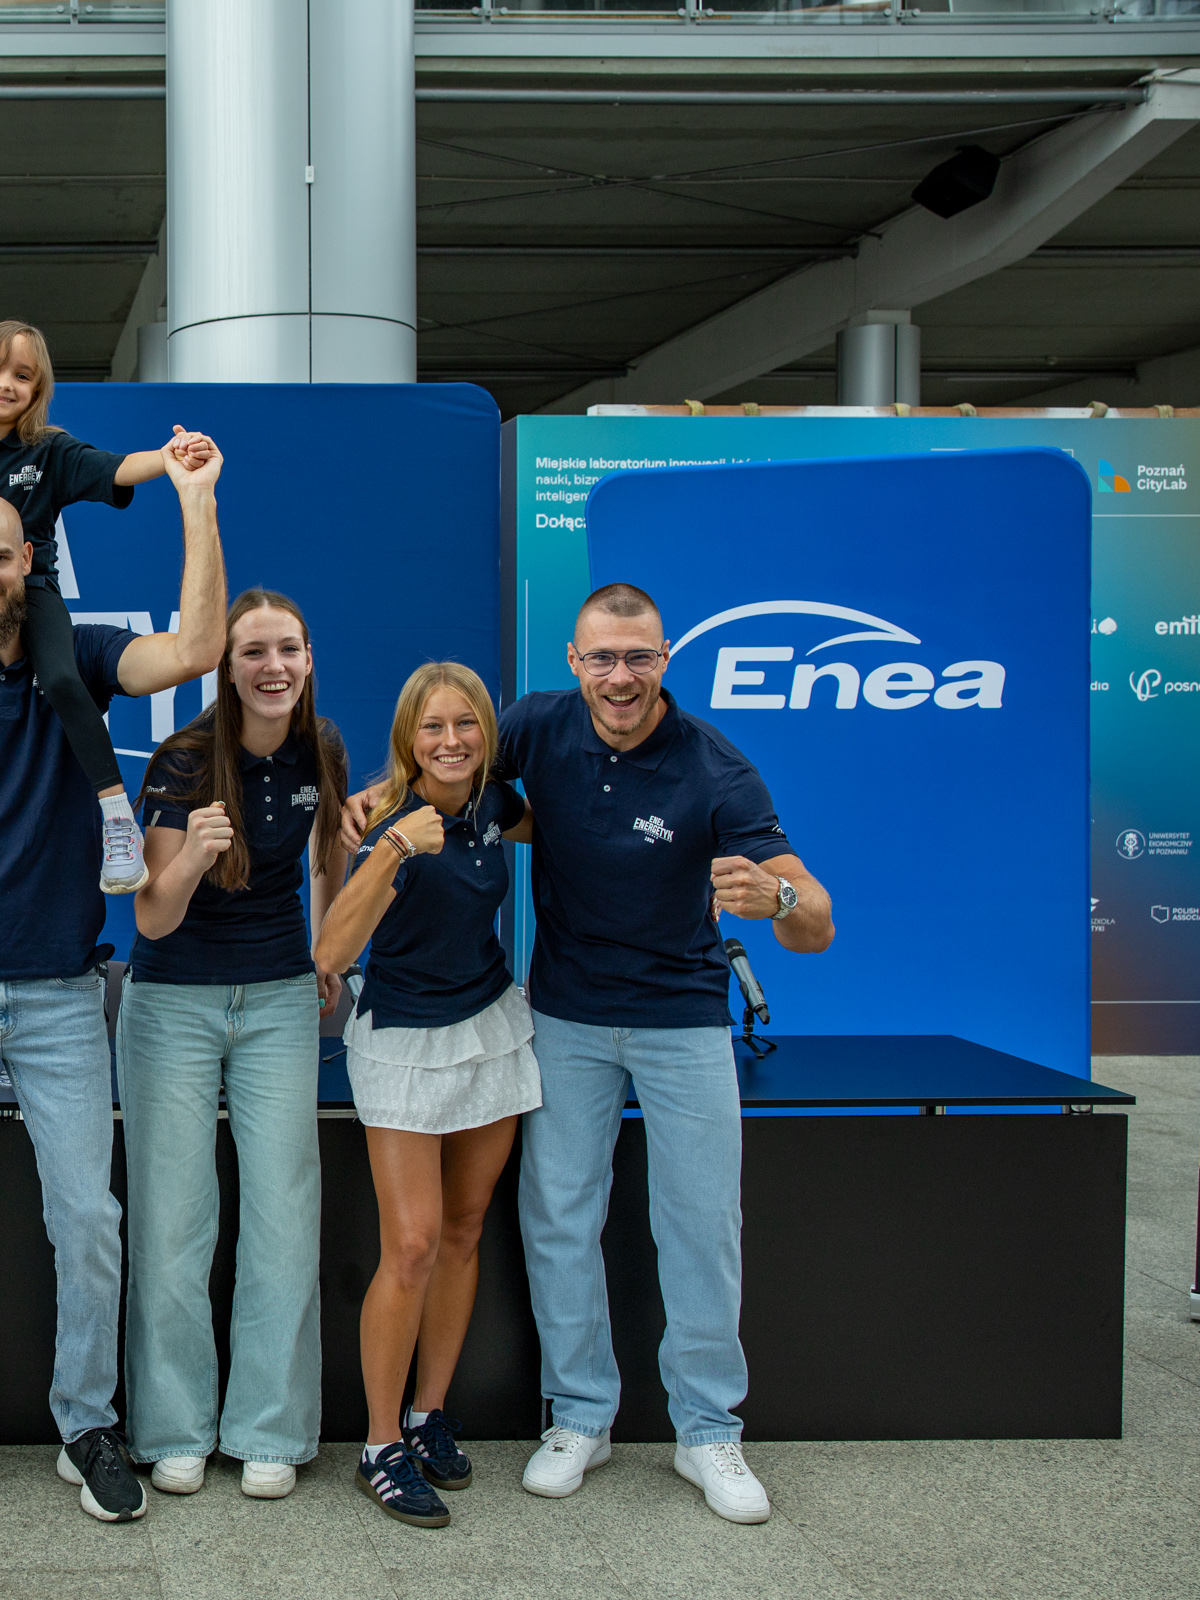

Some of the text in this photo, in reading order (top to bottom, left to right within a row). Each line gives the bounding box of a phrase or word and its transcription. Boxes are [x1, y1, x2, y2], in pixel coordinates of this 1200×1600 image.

[536, 457, 587, 472] Miejskie
[589, 457, 666, 469] laboratorium
[1137, 464, 1185, 476] Poznań
[535, 474, 603, 486] nauki, bizn
[1137, 478, 1188, 493] CityLab
[535, 490, 590, 504] inteligen
[709, 645, 1006, 711] Enea
[1164, 681, 1200, 694] posn
[300, 785, 317, 794] ENEA
[291, 792, 320, 807] ENERGET
[649, 815, 665, 828] ENEA
[632, 817, 675, 843] ENERGETYK
[1148, 832, 1190, 840] UNIWERSYTET
[1148, 840, 1193, 848] EKONOMICZNY
[1148, 848, 1155, 856] W
[1156, 848, 1188, 856] POZNANIU
[1172, 907, 1200, 915] POLISH
